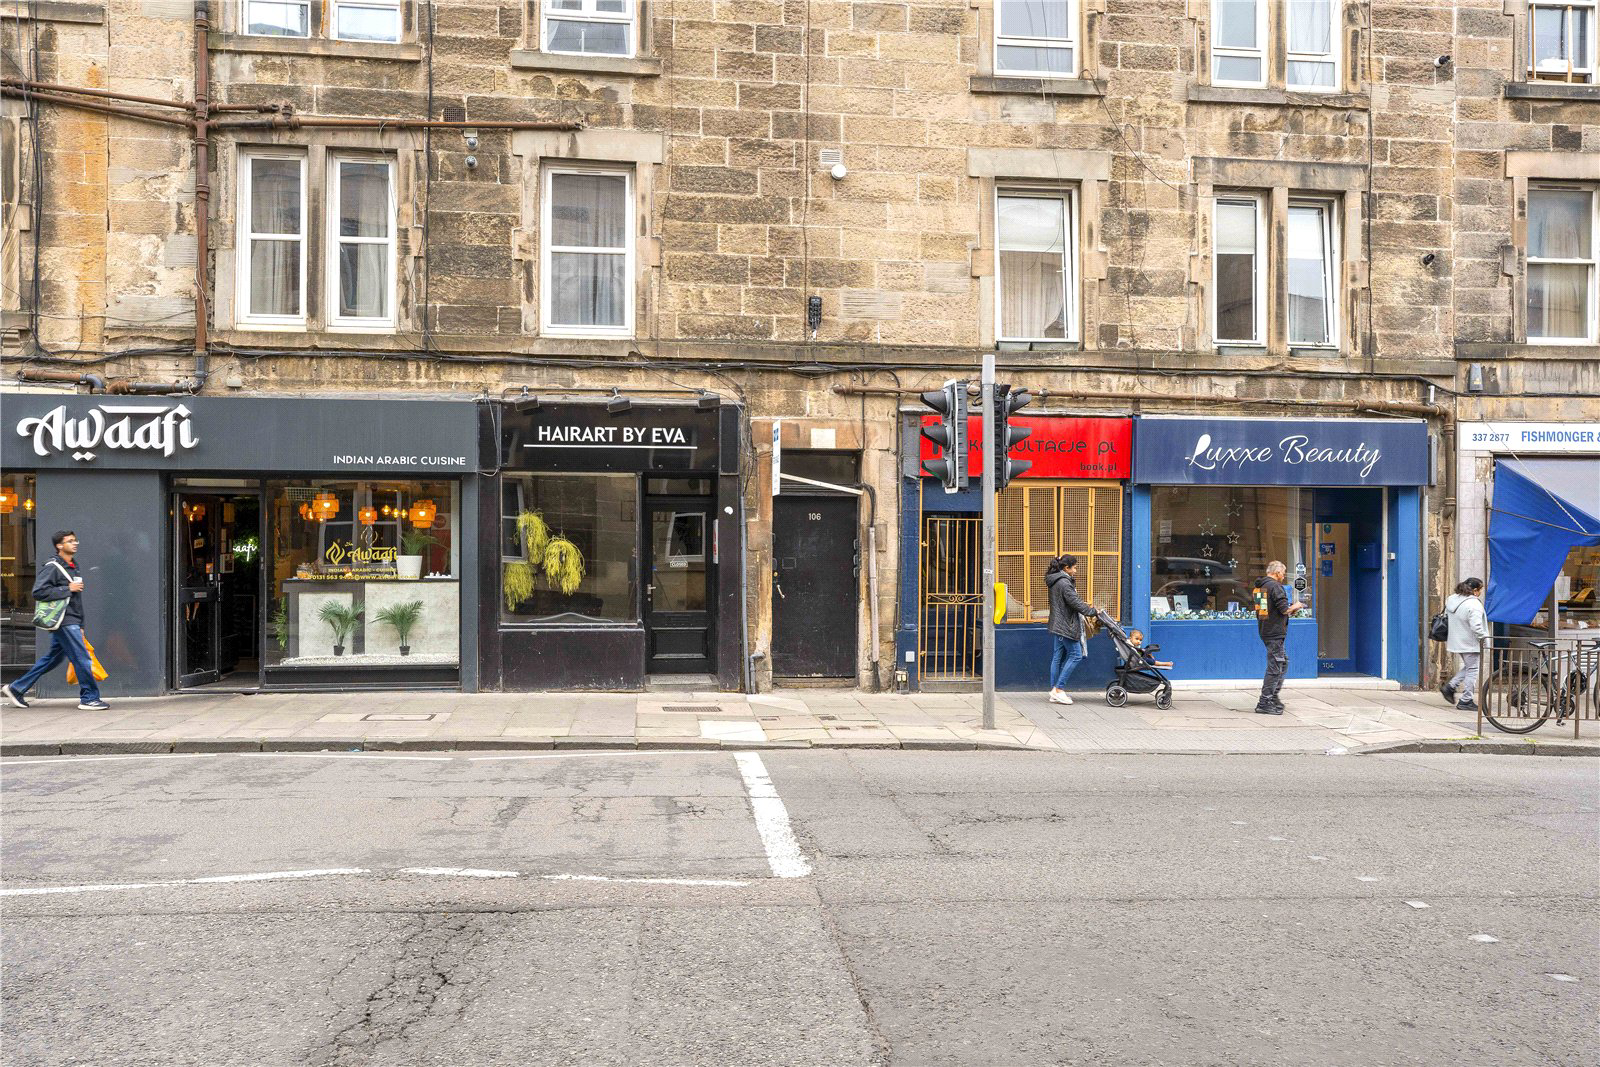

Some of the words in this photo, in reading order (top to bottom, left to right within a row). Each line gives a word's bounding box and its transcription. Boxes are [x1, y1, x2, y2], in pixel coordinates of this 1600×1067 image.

[16, 403, 200, 461] Awaafi
[538, 426, 617, 442] HAIRART
[623, 427, 646, 442] BY
[652, 428, 686, 443] EVA
[1472, 433, 1487, 442] 337
[1489, 433, 1510, 442] 2877
[1521, 430, 1594, 443] FISHMONGER
[333, 455, 374, 464] INDIAN
[376, 456, 418, 465] ARABIC
[420, 456, 466, 466] CUISINE
[1184, 433, 1273, 470] Luxxe
[1279, 435, 1382, 478] Beauty
[1080, 461, 1117, 473] book.pl
[808, 512, 822, 521] 106
[347, 546, 399, 564] Awaafi
